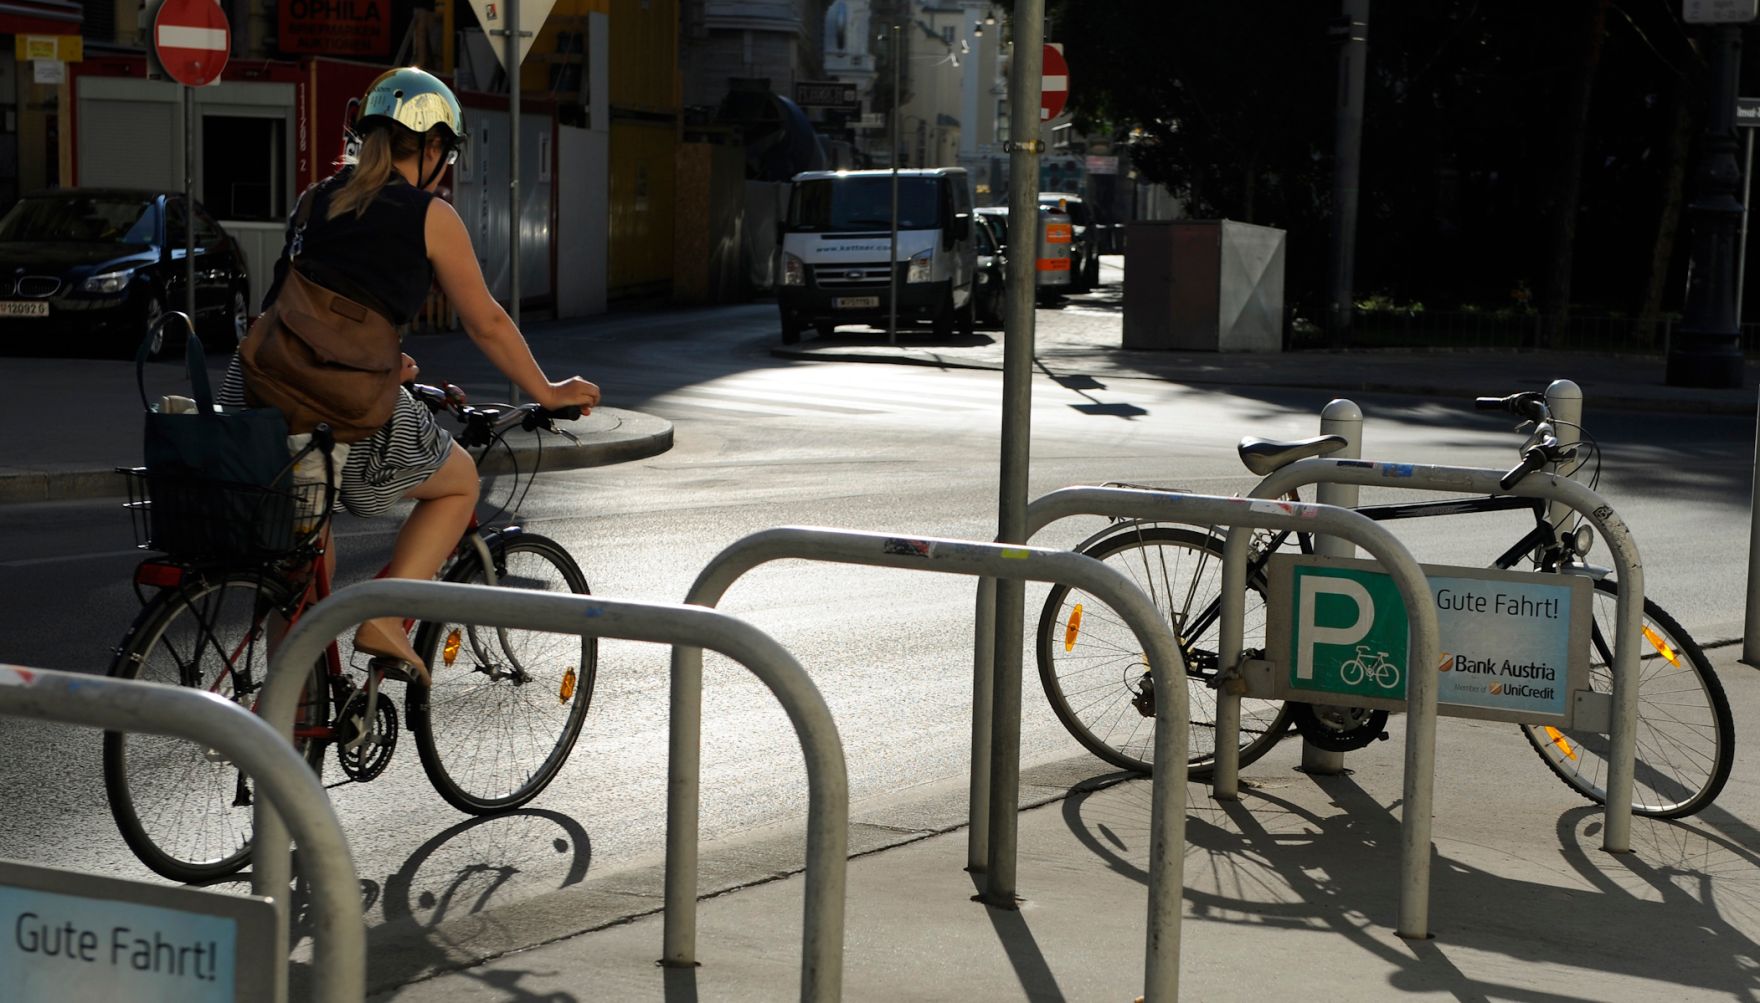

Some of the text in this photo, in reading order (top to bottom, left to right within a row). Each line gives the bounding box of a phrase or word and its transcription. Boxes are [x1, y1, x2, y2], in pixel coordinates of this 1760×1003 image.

[1437, 589, 1559, 619] Gute Fahrt!
[1297, 575, 1375, 680] P
[1455, 655, 1555, 681] Bank Austria
[1503, 683, 1555, 700] UniCredit
[15, 911, 217, 982] Gute Fahrt!
